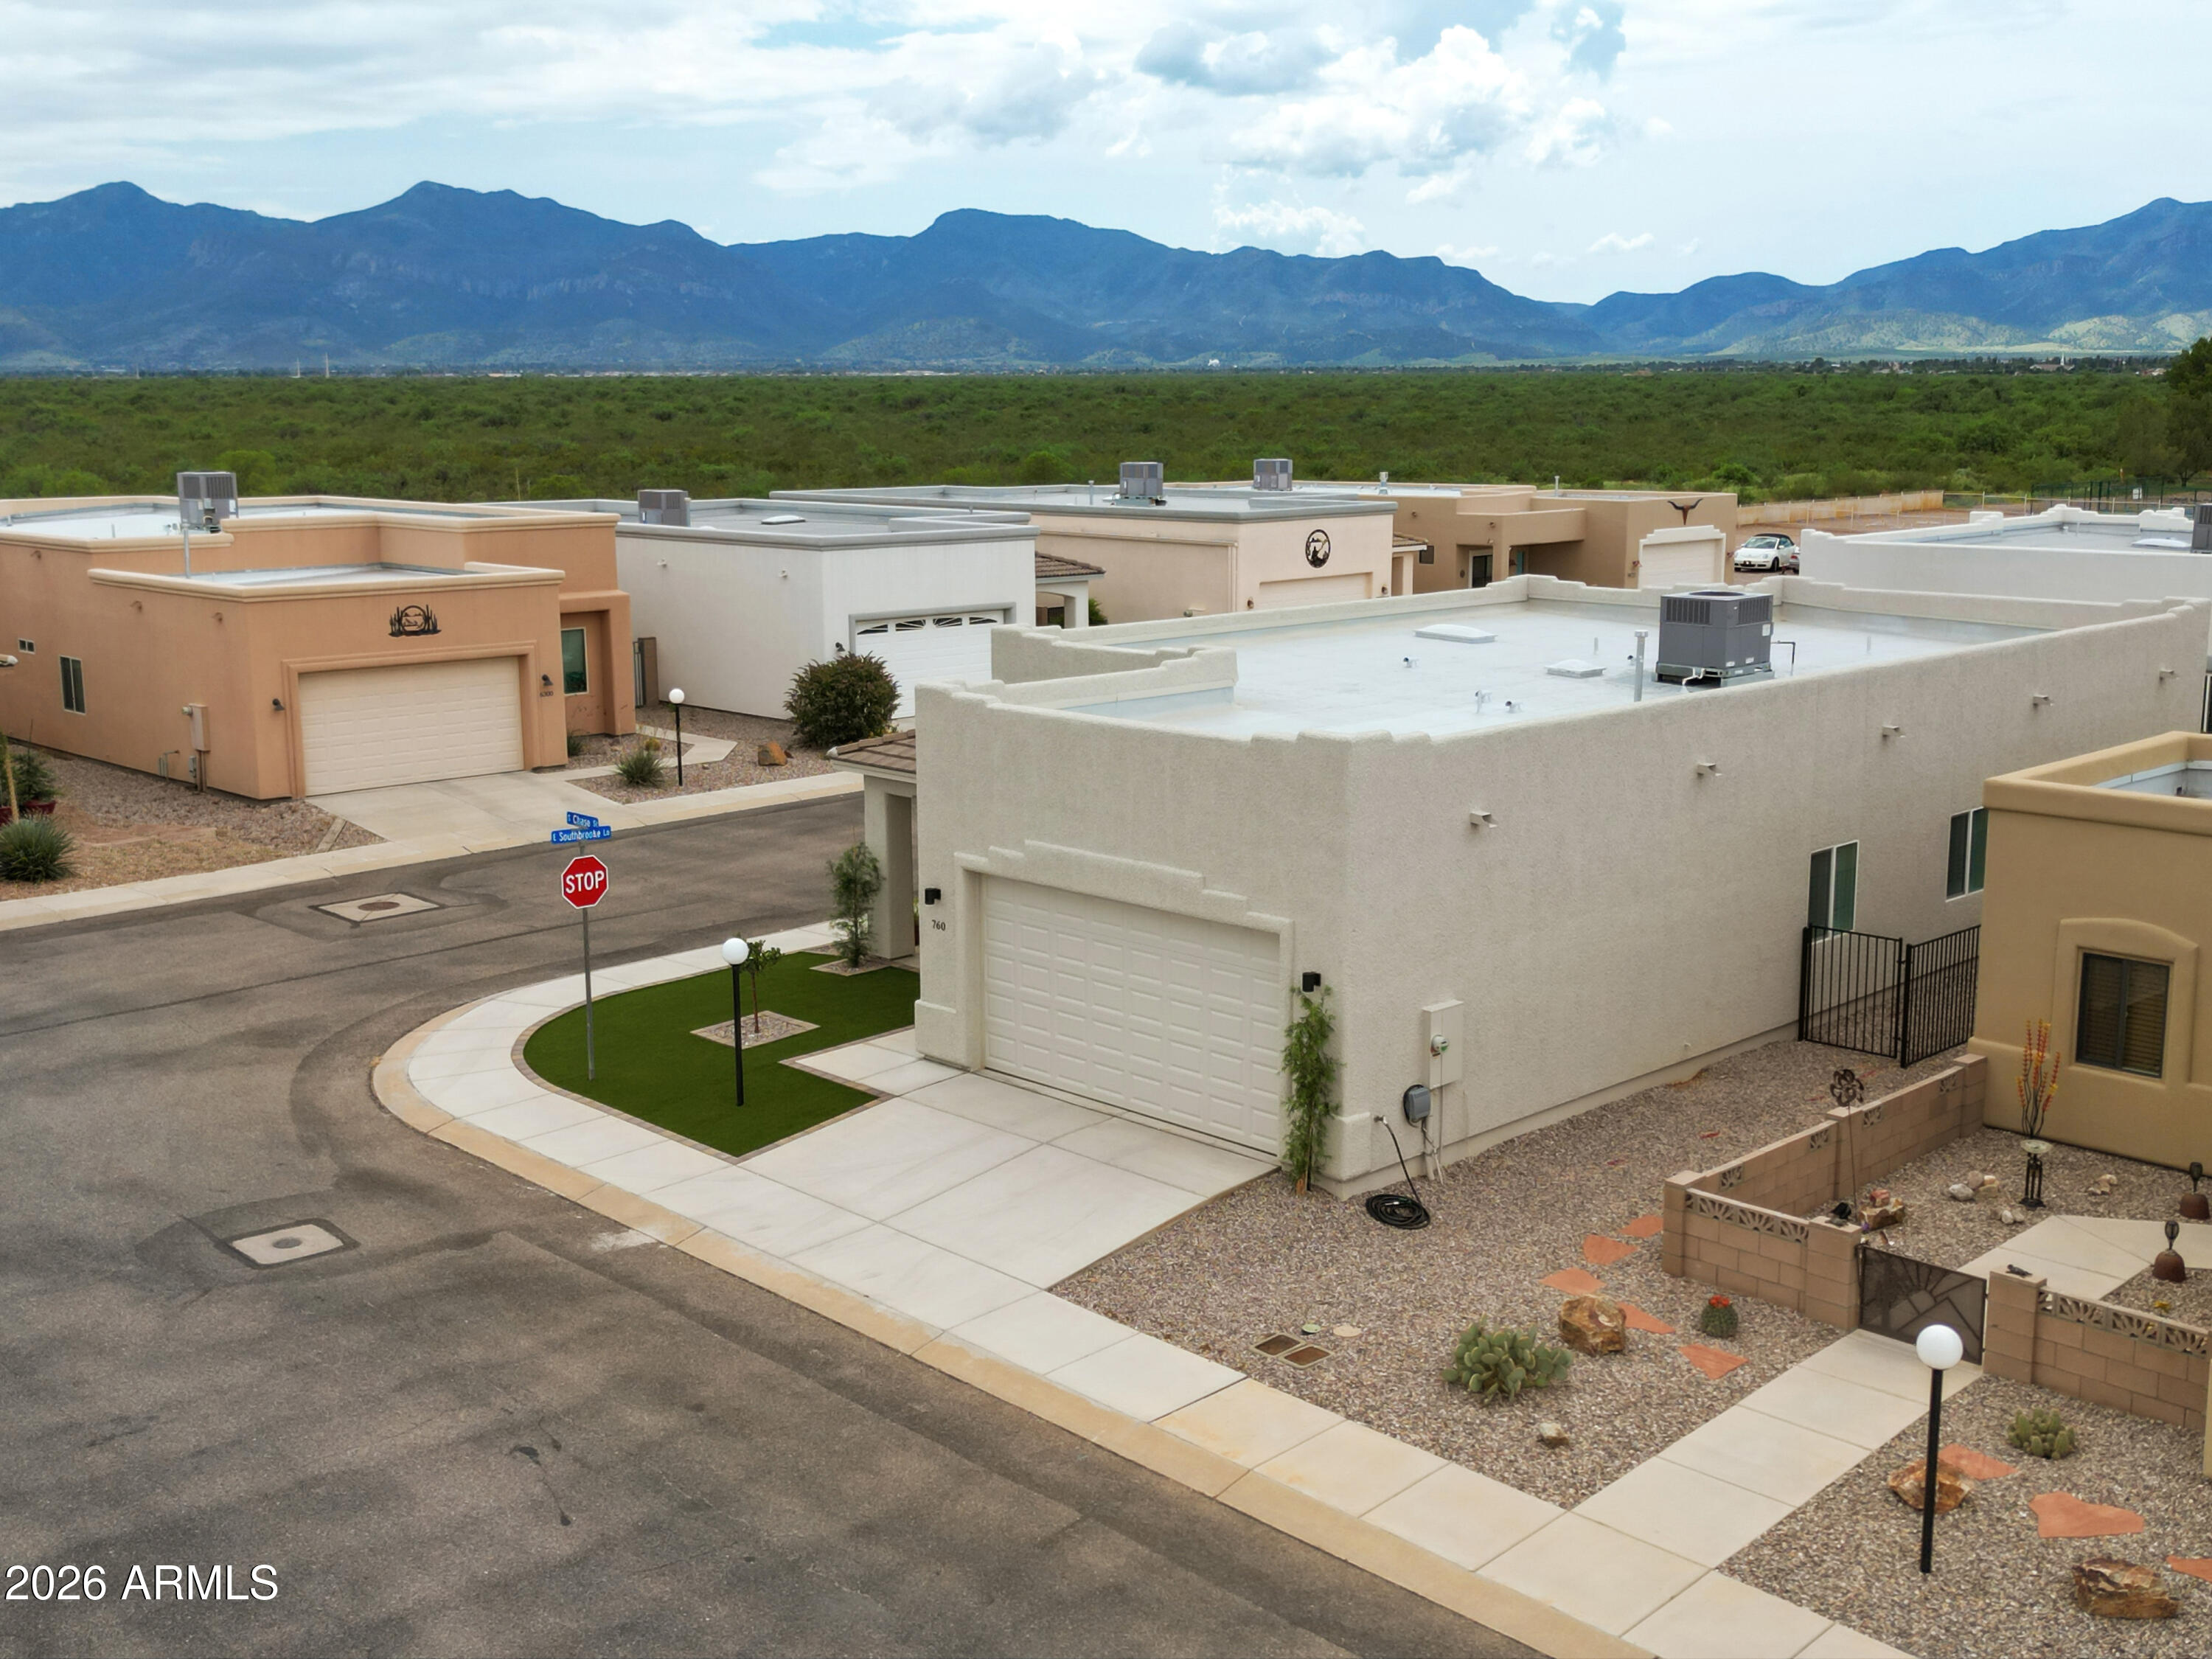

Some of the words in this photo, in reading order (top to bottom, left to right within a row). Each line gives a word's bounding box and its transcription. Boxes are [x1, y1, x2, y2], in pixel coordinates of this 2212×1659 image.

[573, 815, 591, 827] Chase
[553, 832, 557, 841] E
[566, 870, 605, 894] STOP
[931, 919, 946, 931] 760
